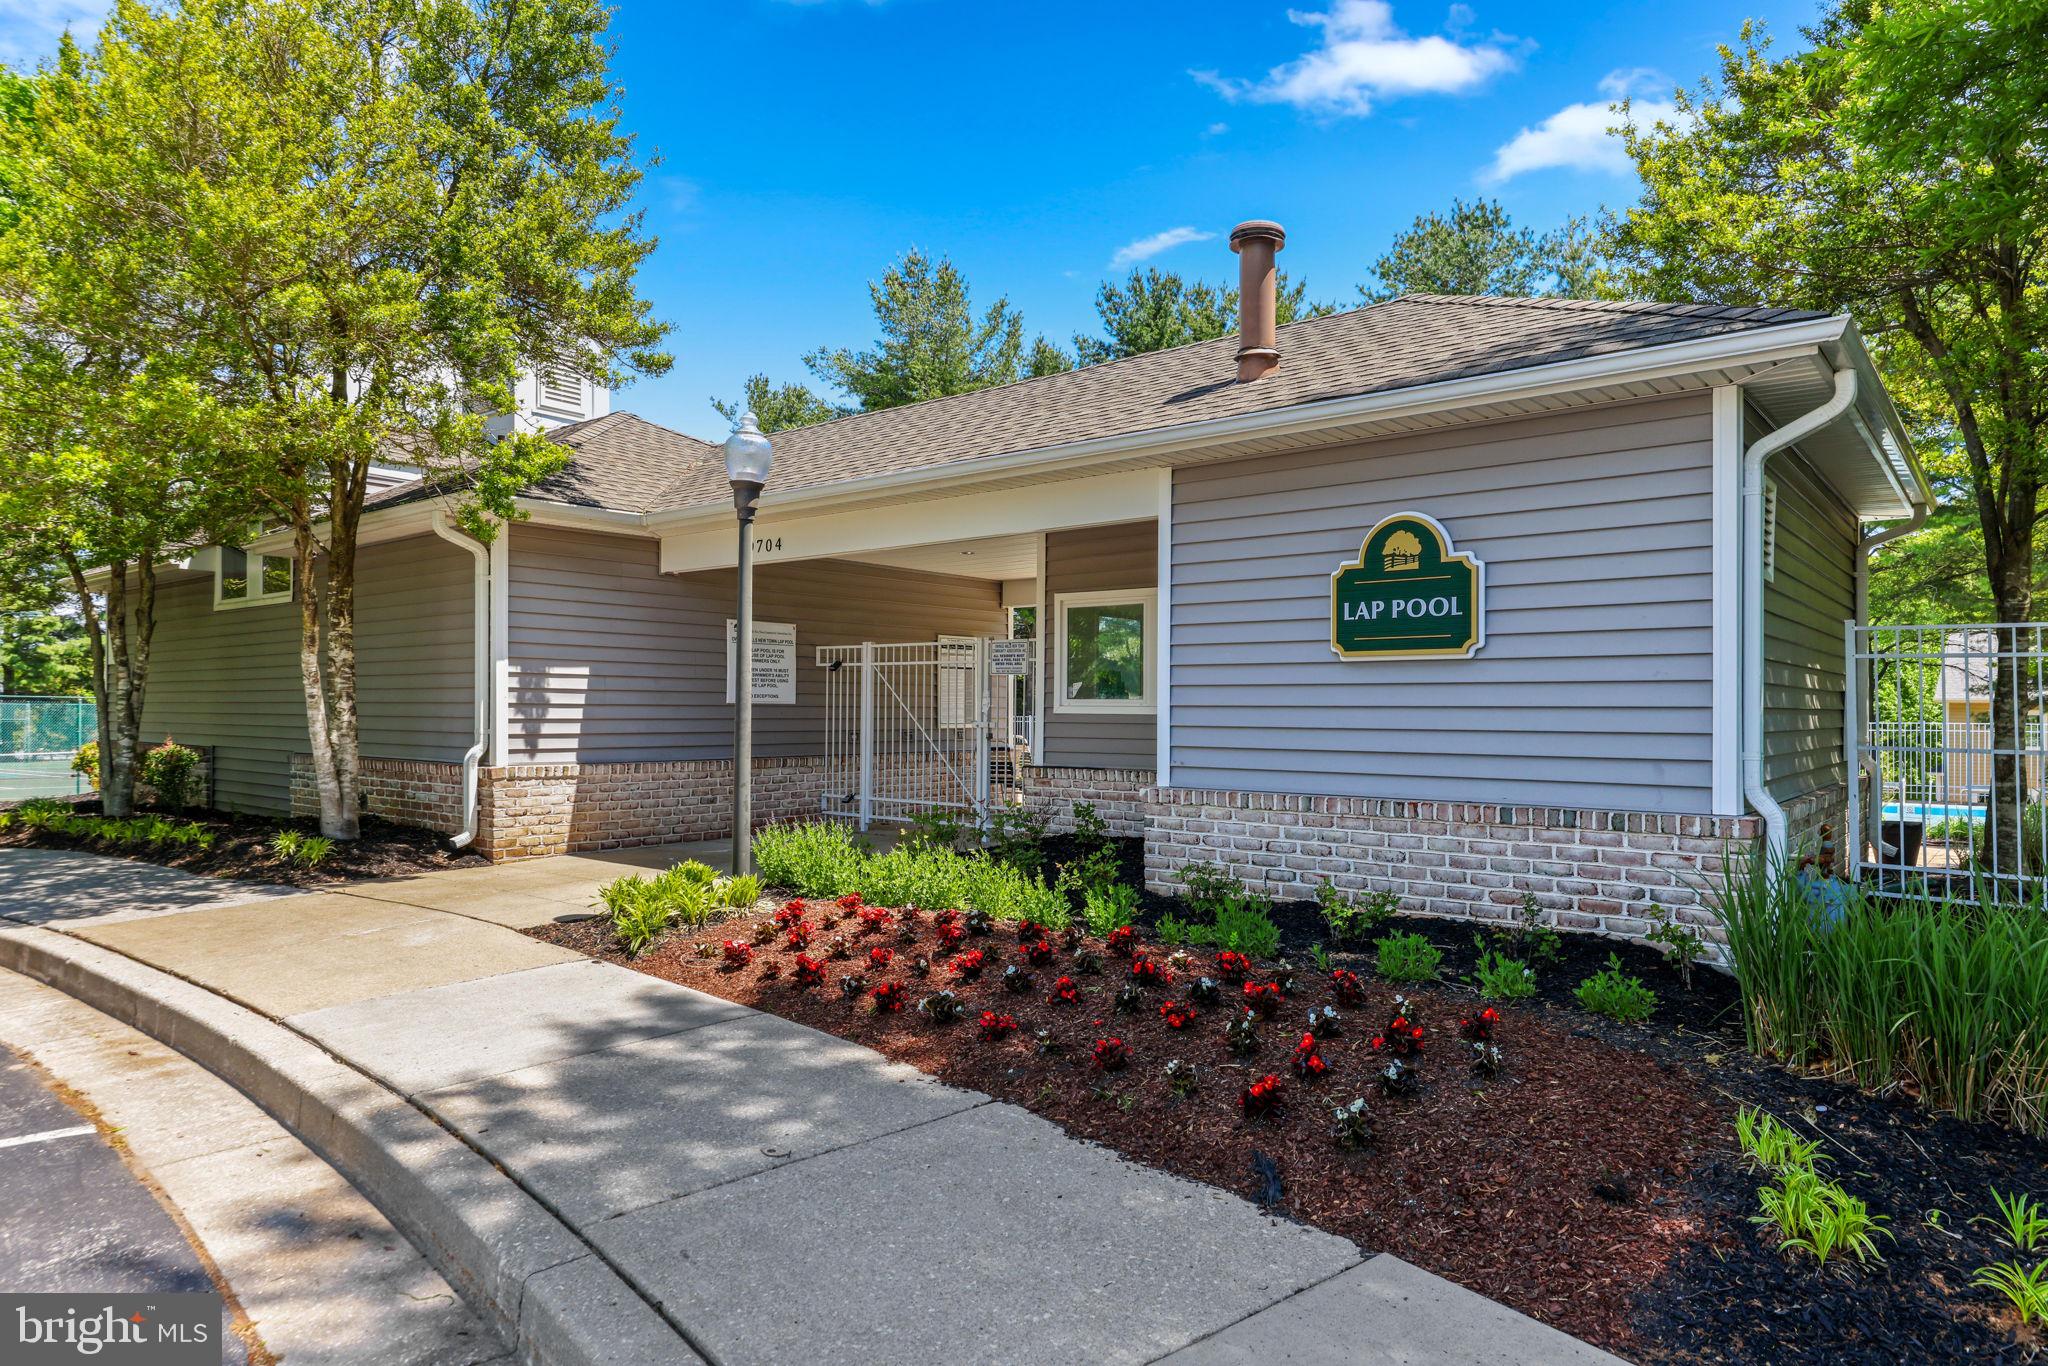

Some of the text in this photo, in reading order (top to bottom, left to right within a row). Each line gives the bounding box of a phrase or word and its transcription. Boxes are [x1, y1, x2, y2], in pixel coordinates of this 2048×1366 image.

[752, 537, 782, 553] 704
[1343, 596, 1463, 621] LAP POOL
